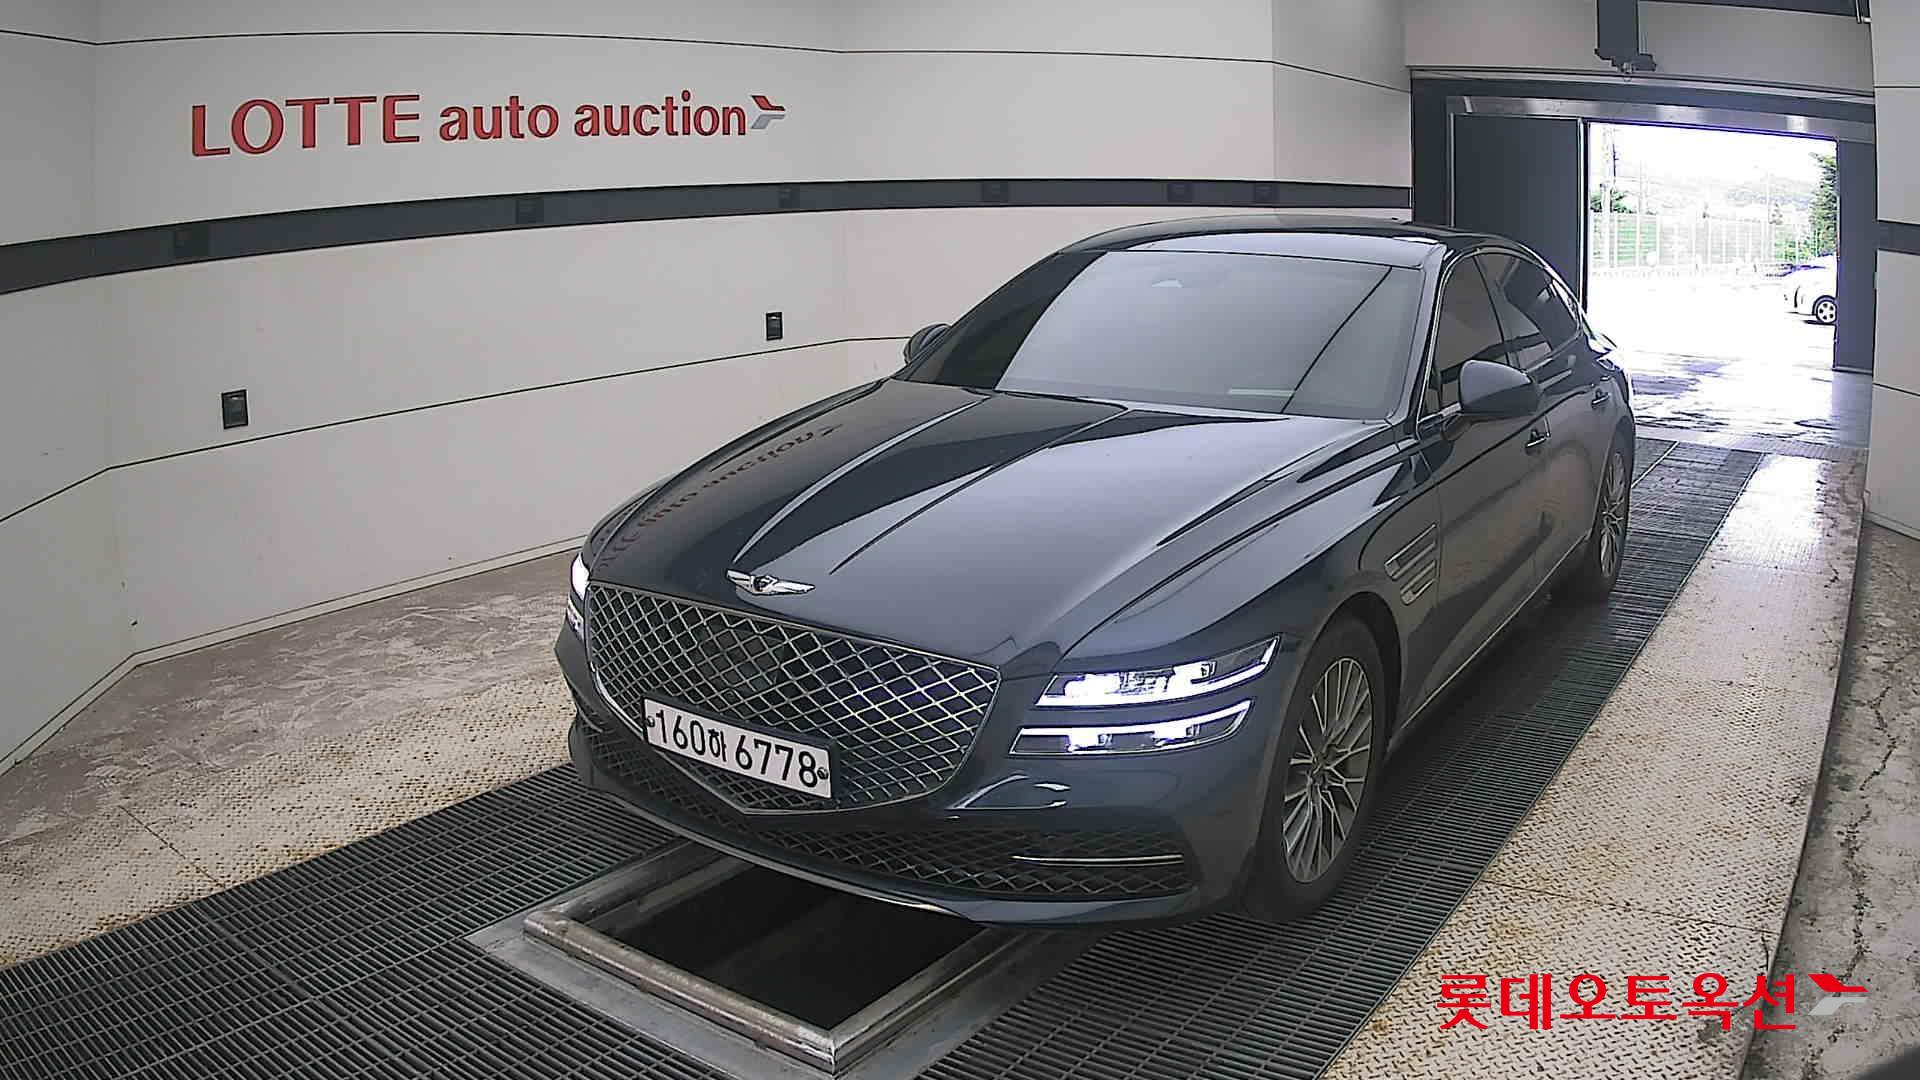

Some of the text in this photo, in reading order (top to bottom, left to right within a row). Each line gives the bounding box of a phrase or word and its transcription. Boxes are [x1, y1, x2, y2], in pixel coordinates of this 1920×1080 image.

[191, 90, 746, 157] LOTTE auto auction
[655, 709, 818, 788] 160하 6778
